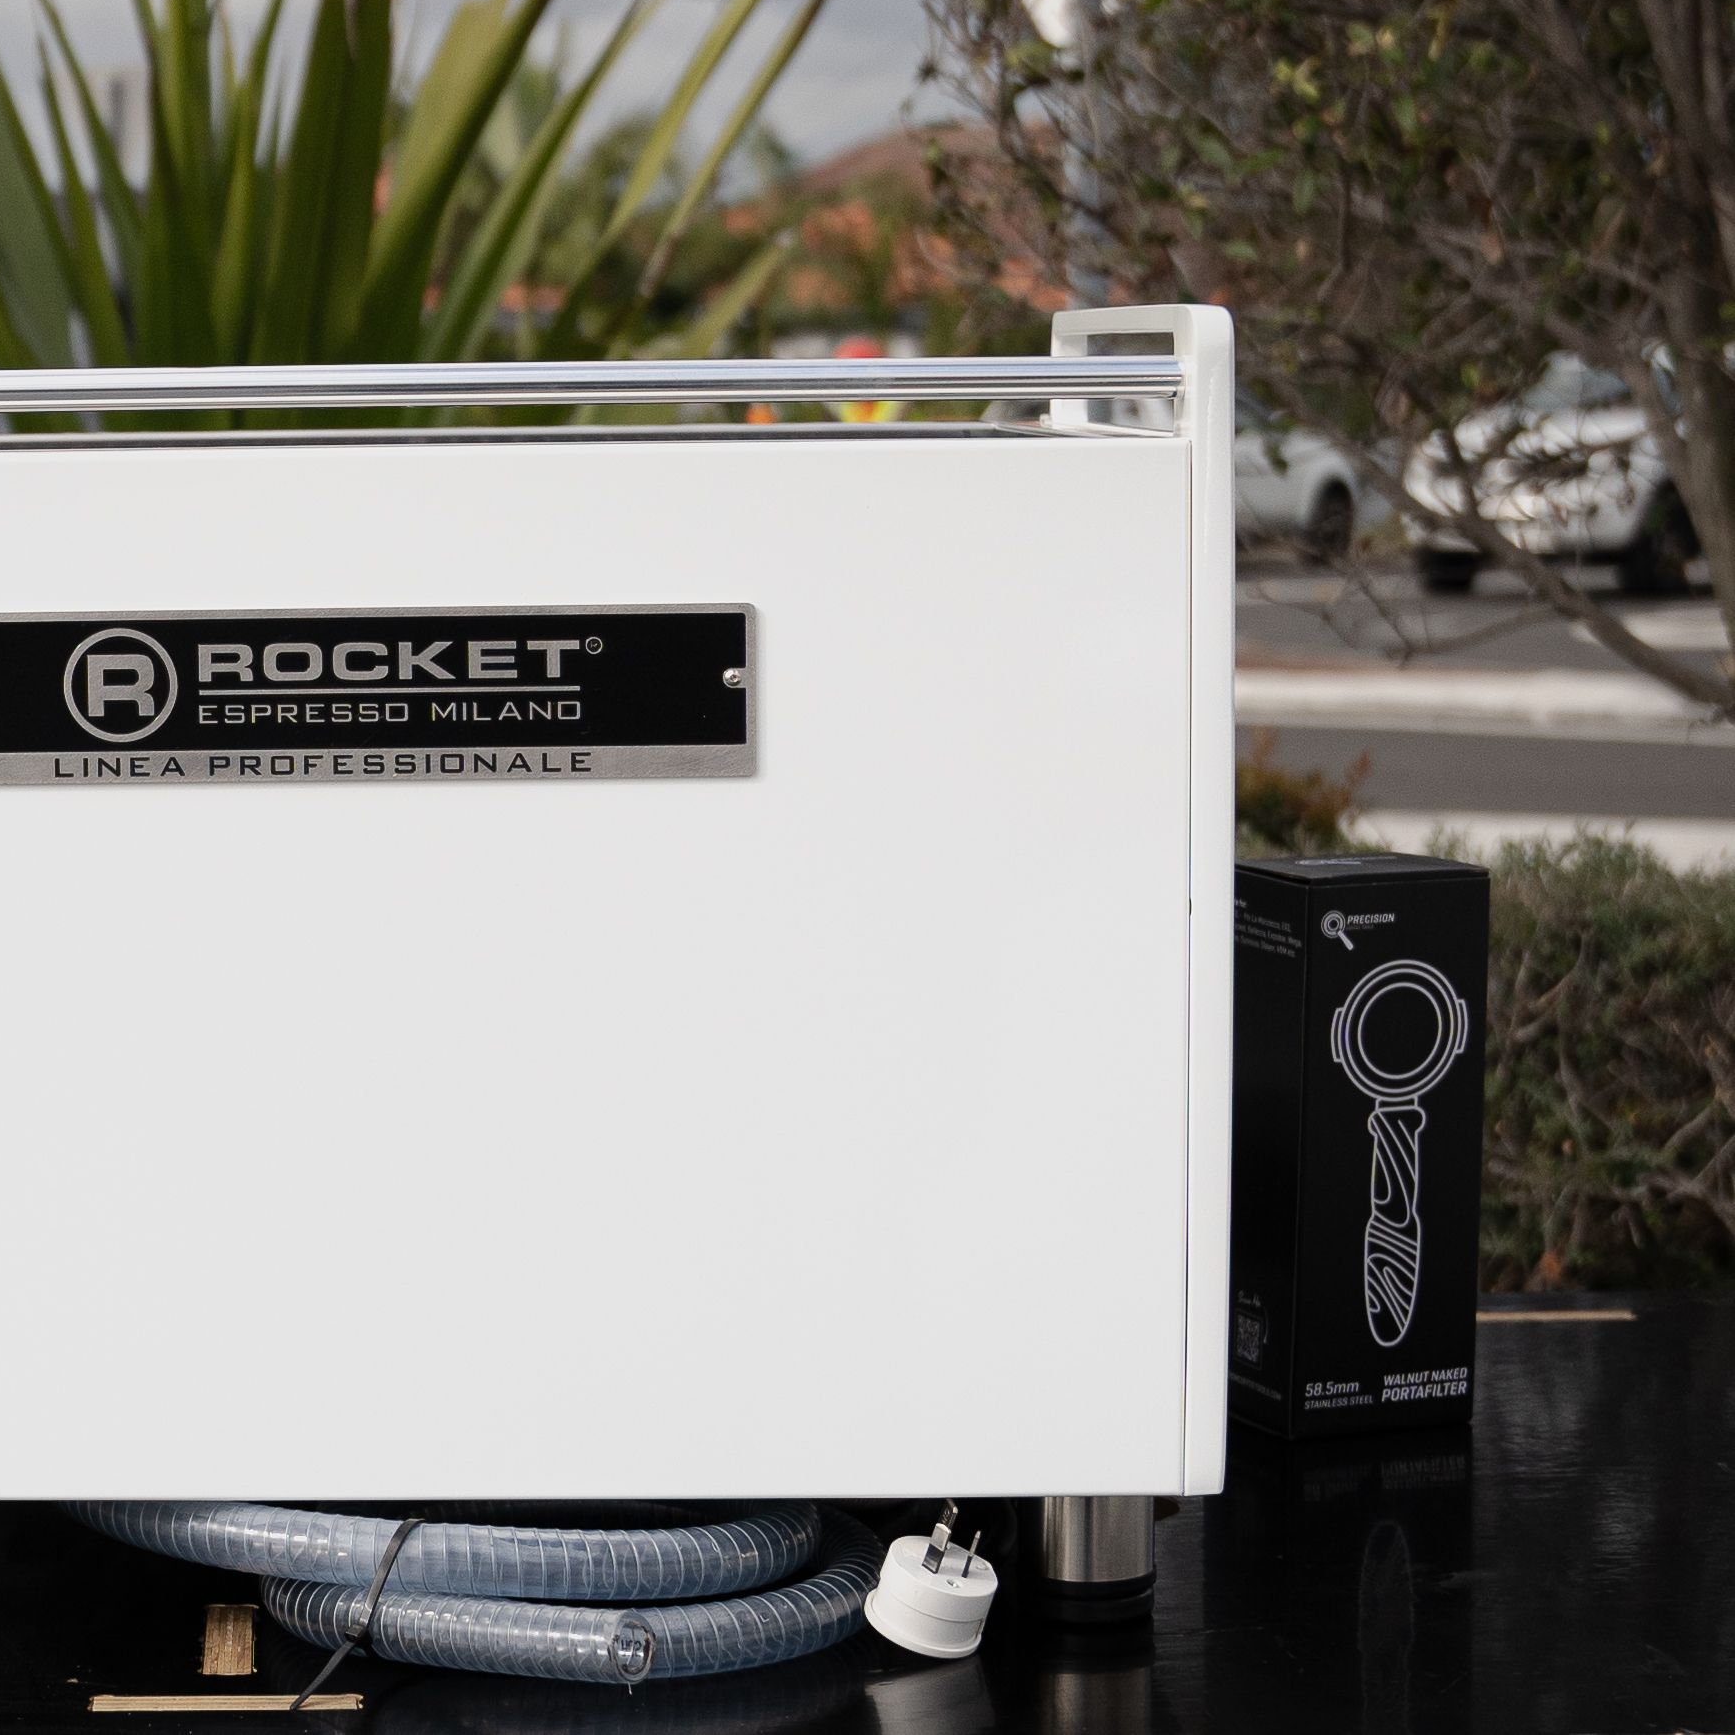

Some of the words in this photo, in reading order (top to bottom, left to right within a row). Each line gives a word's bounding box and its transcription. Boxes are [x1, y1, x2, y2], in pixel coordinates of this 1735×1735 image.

[198, 703, 409, 725] ESPRESSO
[431, 701, 581, 722] MILANO
[53, 756, 186, 778] LINEA
[208, 752, 592, 777] PROFESSIONALE
[1346, 913, 1395, 925] PRECISION
[1383, 1370, 1430, 1386] WALNUT
[1431, 1367, 1468, 1381] NAKED
[1305, 1381, 1360, 1397] 58.5mm
[1381, 1381, 1467, 1403] PORTAFILTER
[1304, 1396, 1349, 1410] STAINLESS
[1349, 1394, 1374, 1405] STEEL
